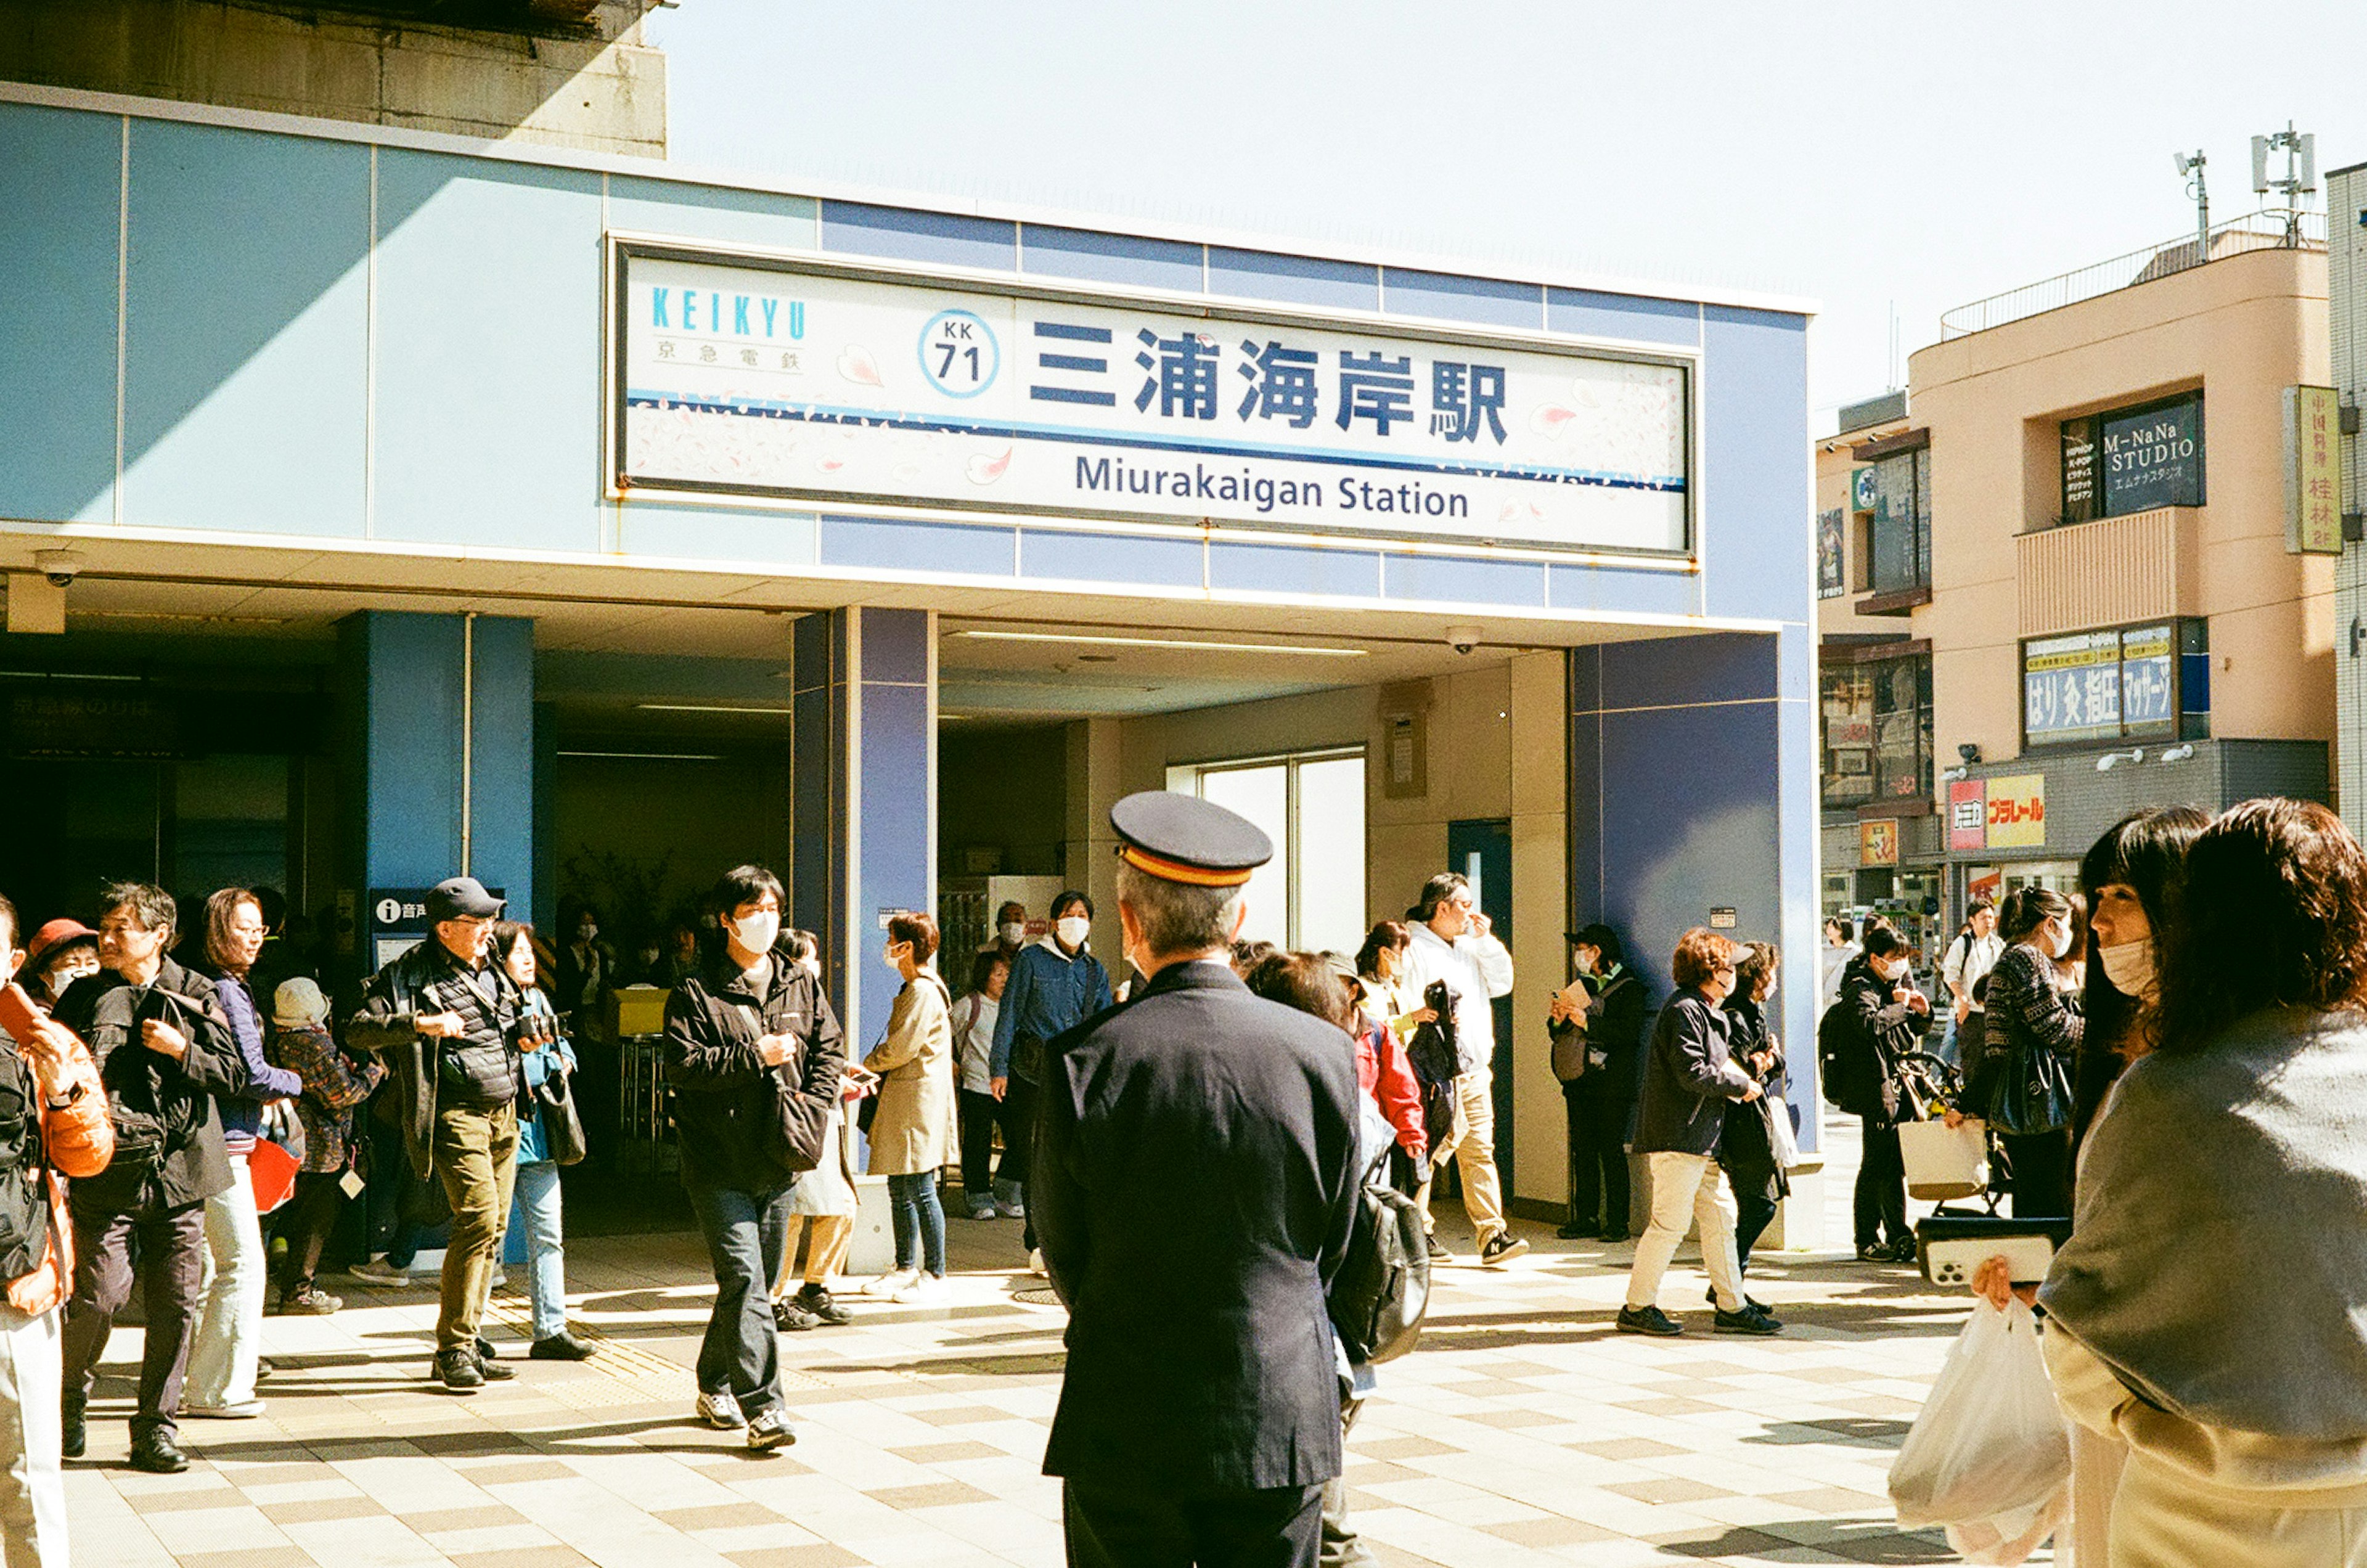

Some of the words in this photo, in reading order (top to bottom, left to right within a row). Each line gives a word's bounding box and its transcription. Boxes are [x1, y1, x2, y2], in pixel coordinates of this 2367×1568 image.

[652, 287, 805, 340] KEIKYU
[944, 321, 972, 340] KK
[658, 340, 801, 370] 京急電鉄
[935, 343, 979, 382] 71
[1029, 321, 1508, 446] 三浦海岸駅
[2112, 438, 2193, 472] STUDIO
[1075, 455, 1323, 513] Miurakaigan
[1338, 476, 1469, 518] Station
[2309, 477, 2334, 526] 桂林
[2313, 531, 2332, 545] 2F
[1954, 800, 1982, 829] トミカ
[1989, 797, 2043, 824] プラレール
